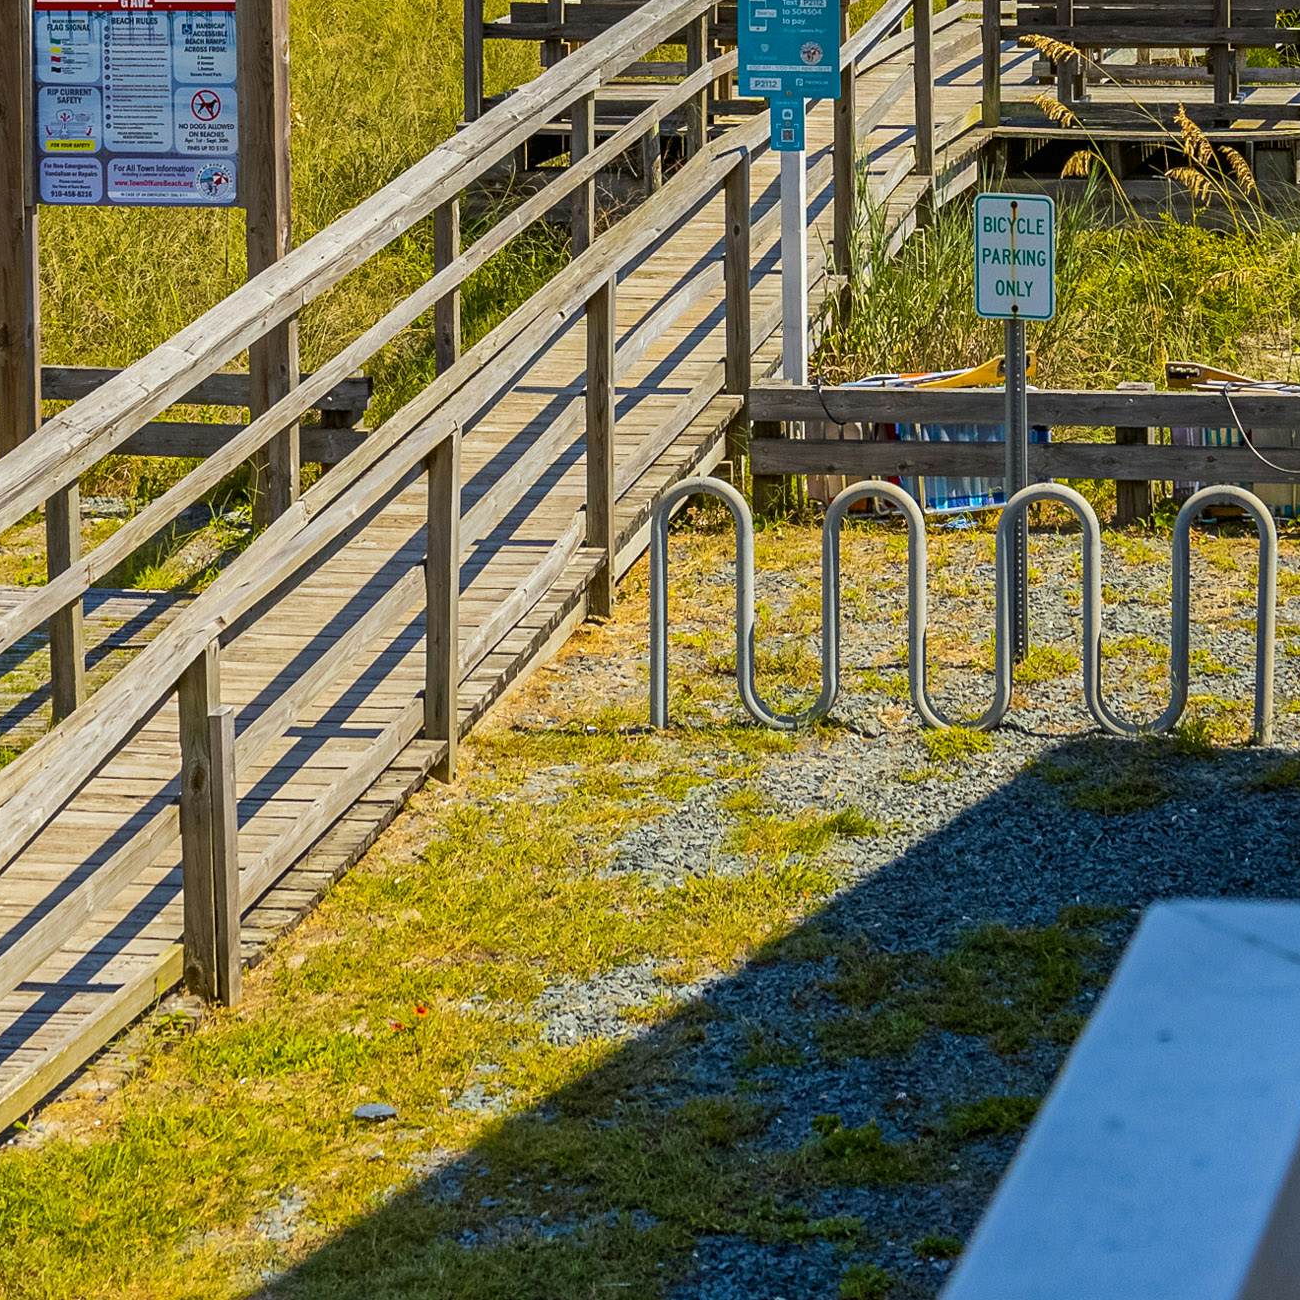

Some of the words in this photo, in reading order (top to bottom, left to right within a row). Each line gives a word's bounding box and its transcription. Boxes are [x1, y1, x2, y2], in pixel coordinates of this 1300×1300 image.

[111, 17, 134, 25] BEACH
[136, 17, 158, 25] RULES
[47, 88, 59, 96] RIP
[57, 96, 82, 104] SAFETY
[113, 164, 125, 172] For
[126, 164, 135, 172] All
[983, 216, 1045, 235] BICYCLE
[982, 248, 1046, 267] PARKING
[995, 279, 1033, 298] ONLY
